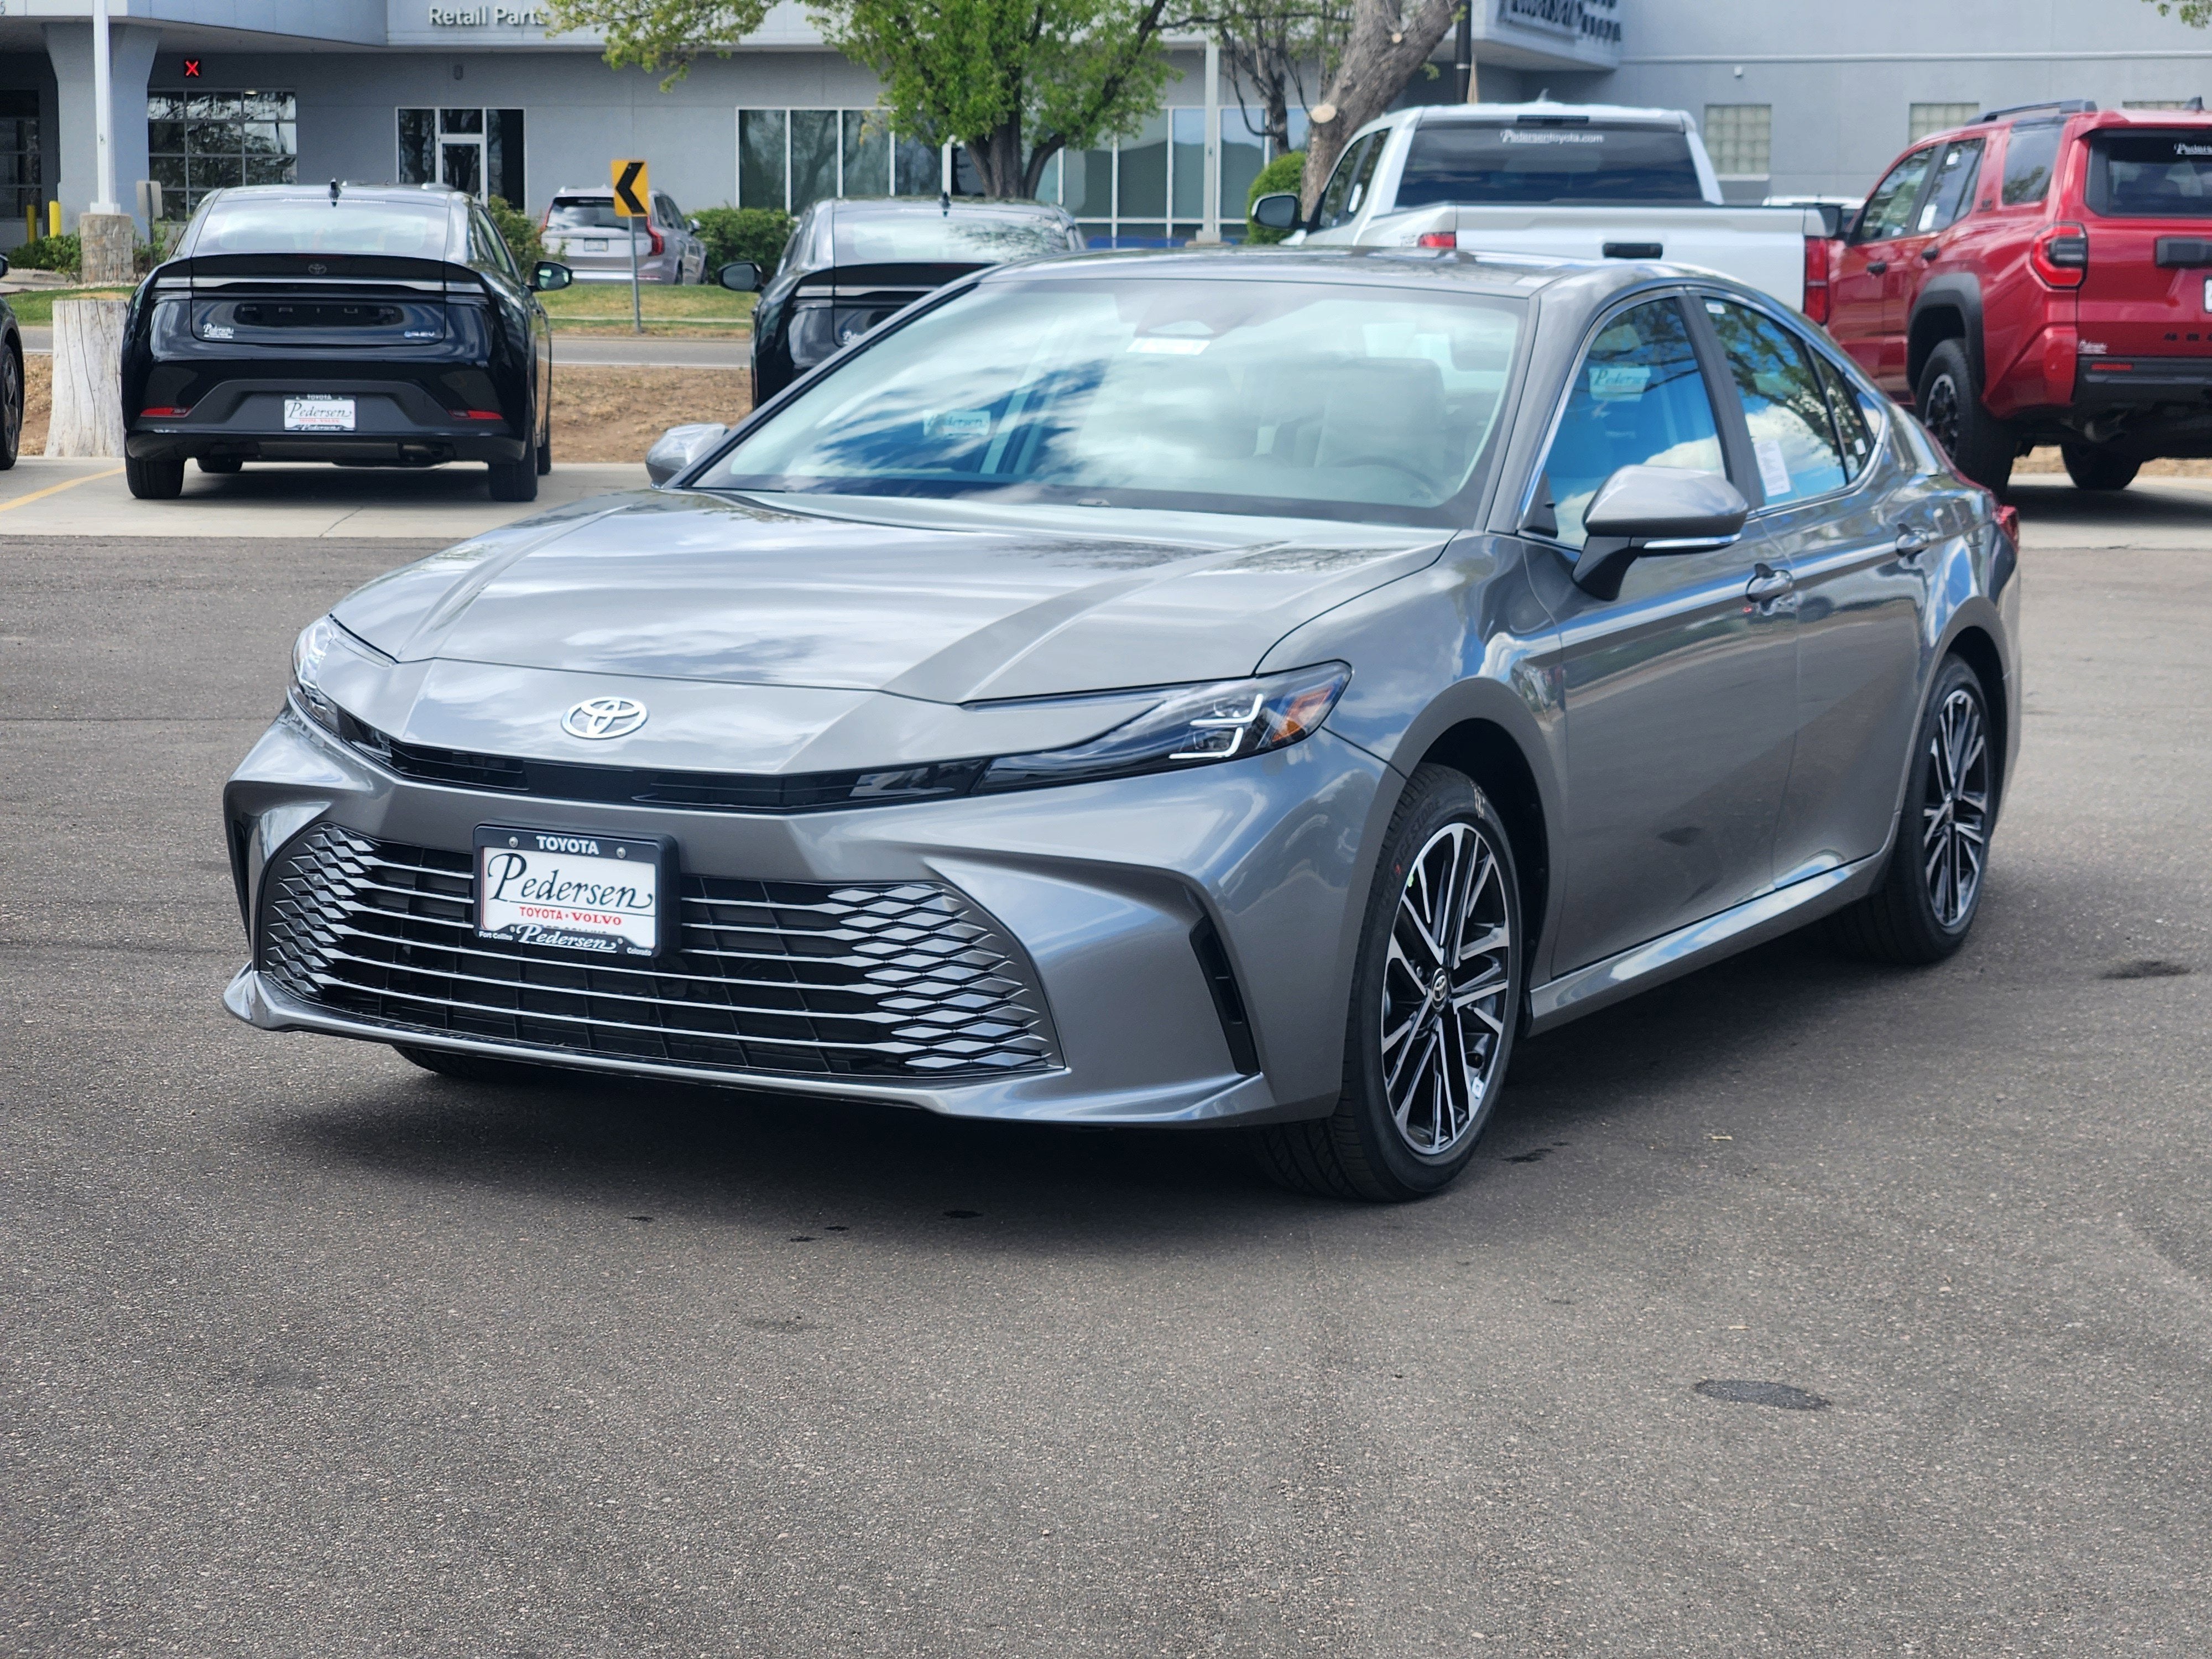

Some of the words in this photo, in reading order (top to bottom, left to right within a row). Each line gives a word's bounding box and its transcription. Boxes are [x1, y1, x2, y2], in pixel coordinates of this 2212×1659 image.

[429, 5, 488, 25] Retail
[286, 402, 352, 419] Pedersen
[535, 836, 599, 854] TOYOTA
[488, 853, 653, 909] Pedersen
[519, 906, 563, 921] TOYOTA
[571, 912, 622, 926] VOLVO
[516, 924, 618, 951] Pedersen
